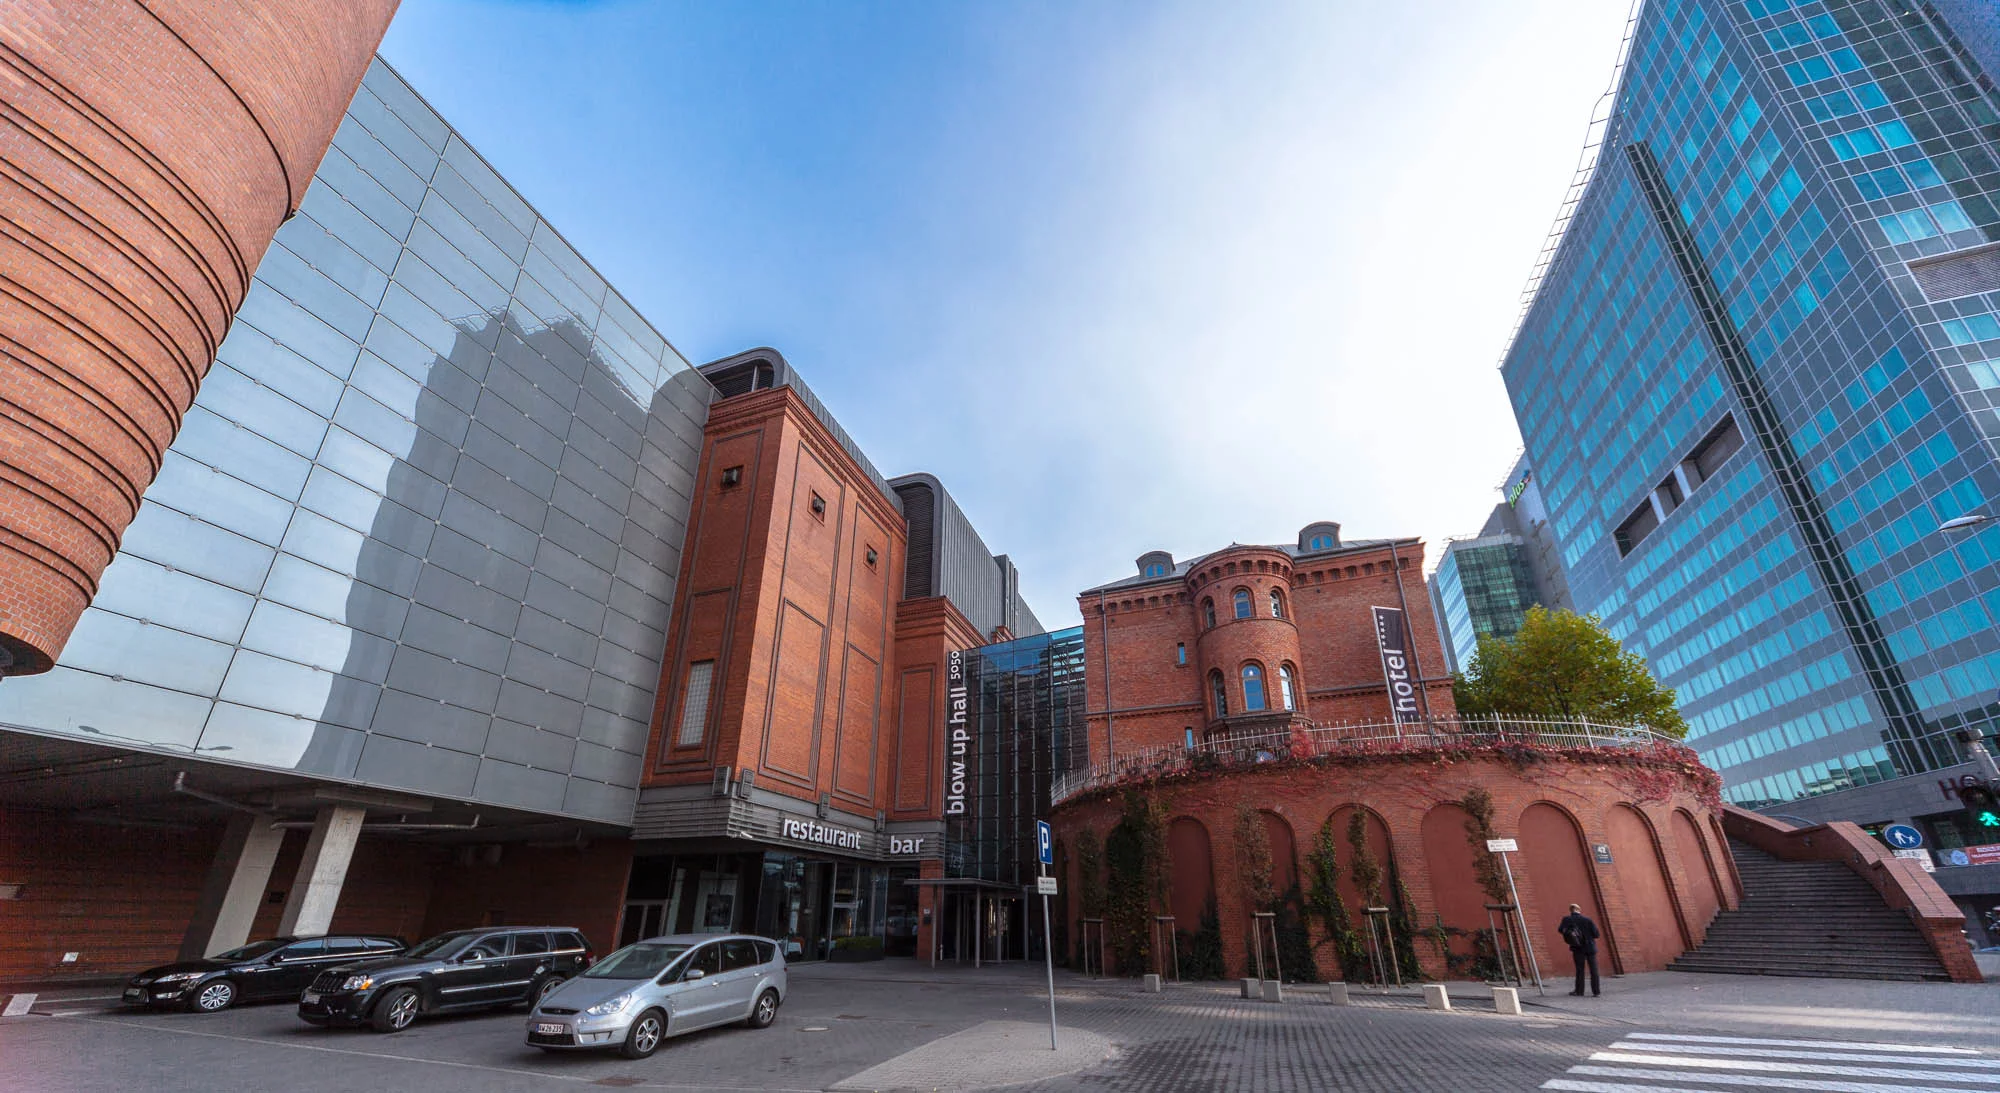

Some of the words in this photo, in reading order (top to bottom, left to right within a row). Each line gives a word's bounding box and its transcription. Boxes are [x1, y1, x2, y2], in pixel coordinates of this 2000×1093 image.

[1509, 479, 1525, 509] plus
[950, 650, 961, 680] 5050
[1383, 648, 1417, 712] hotel
[950, 687, 967, 724] hall
[953, 729, 970, 755] up
[947, 762, 965, 814] blow
[783, 818, 861, 850] restaurant
[890, 835, 924, 854] bar
[1041, 827, 1049, 858] P
